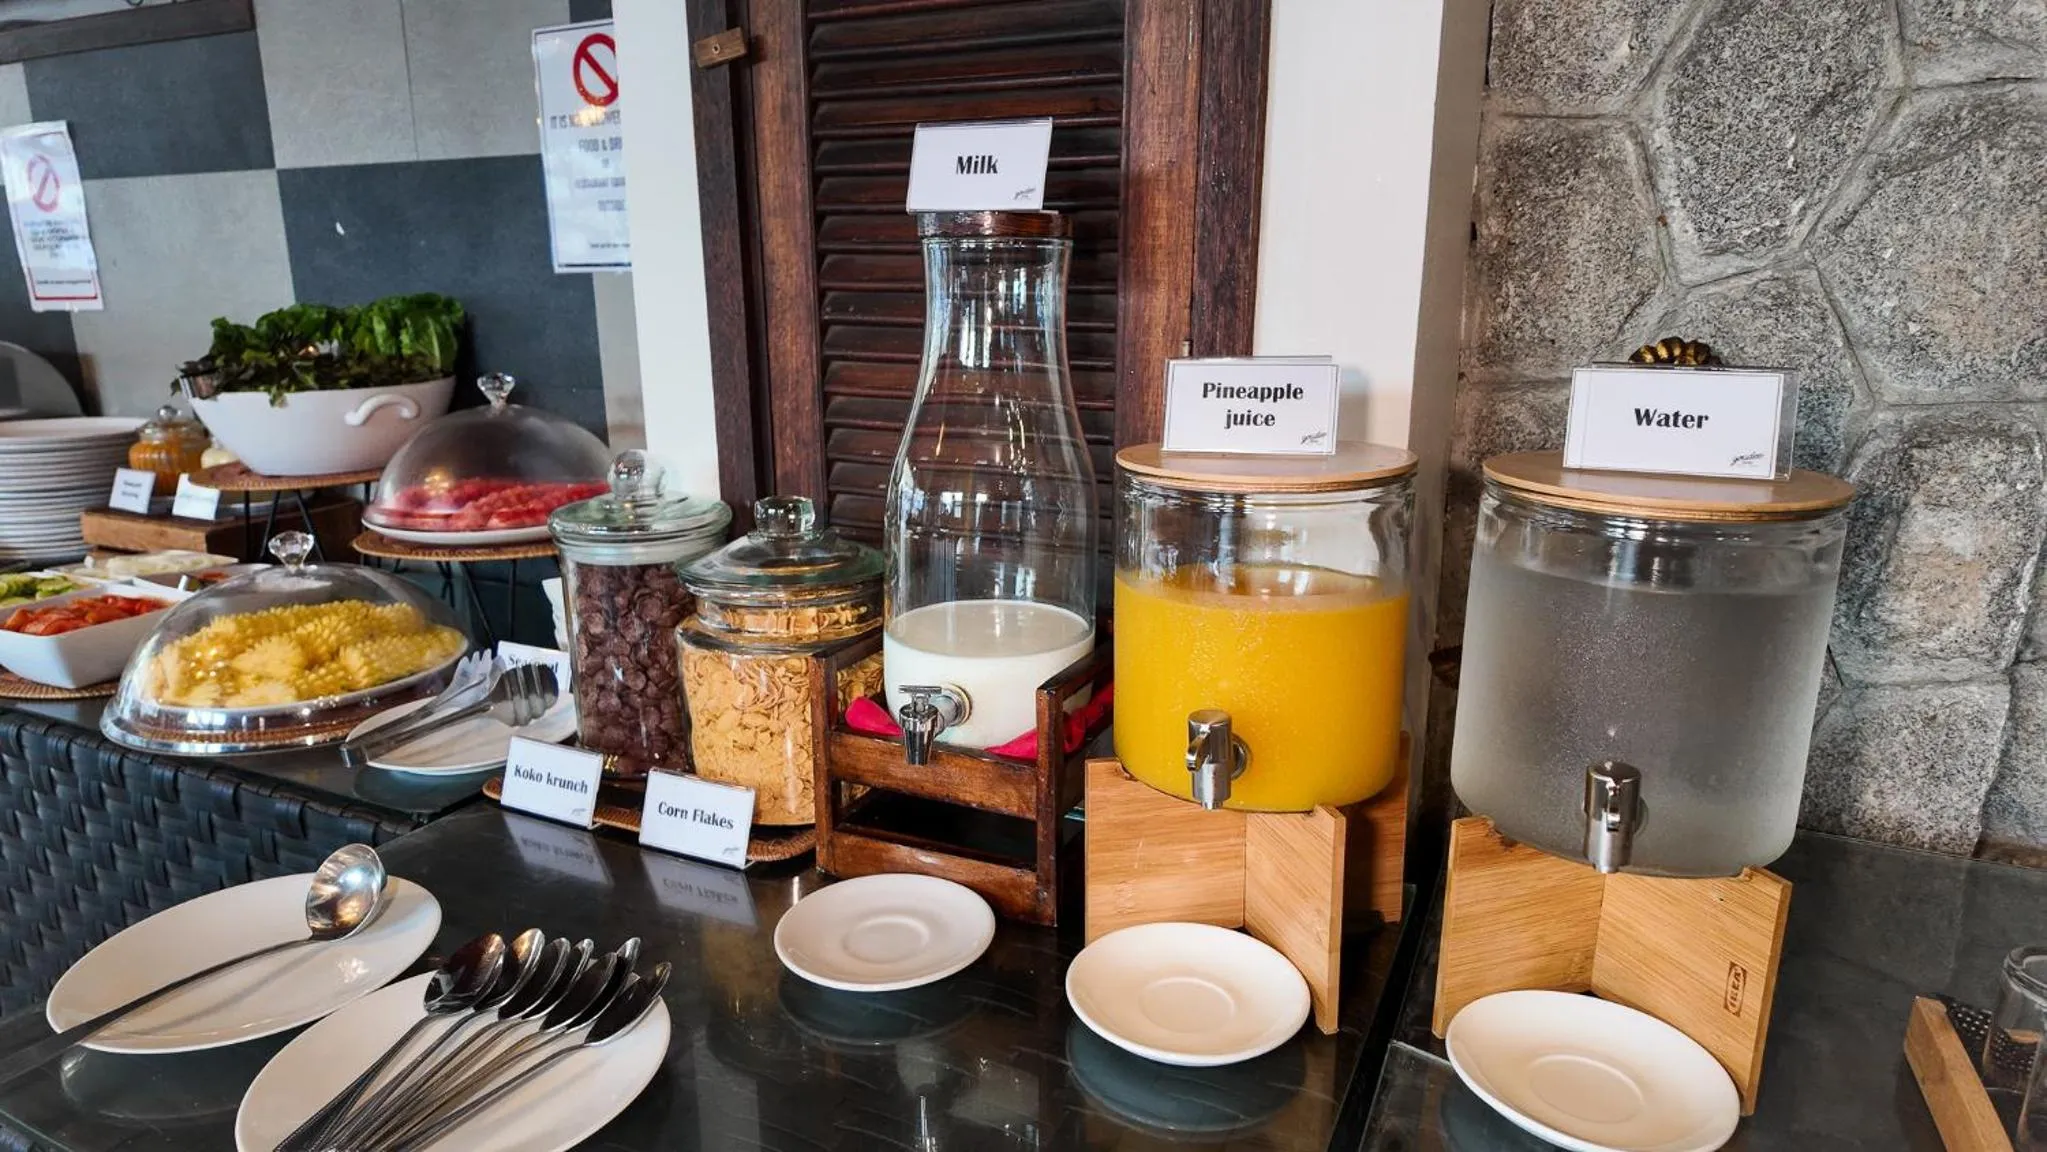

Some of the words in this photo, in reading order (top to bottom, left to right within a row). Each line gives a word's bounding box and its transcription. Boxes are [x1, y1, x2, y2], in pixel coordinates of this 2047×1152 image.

[956, 154, 998, 174] Milk
[1202, 382, 1304, 403] Pineapple
[1224, 409, 1276, 430] juice
[1634, 407, 1709, 429] Water
[514, 764, 543, 784] Koko
[546, 771, 588, 795] krunch
[658, 800, 689, 820] Corn
[692, 808, 734, 831] Flakes
